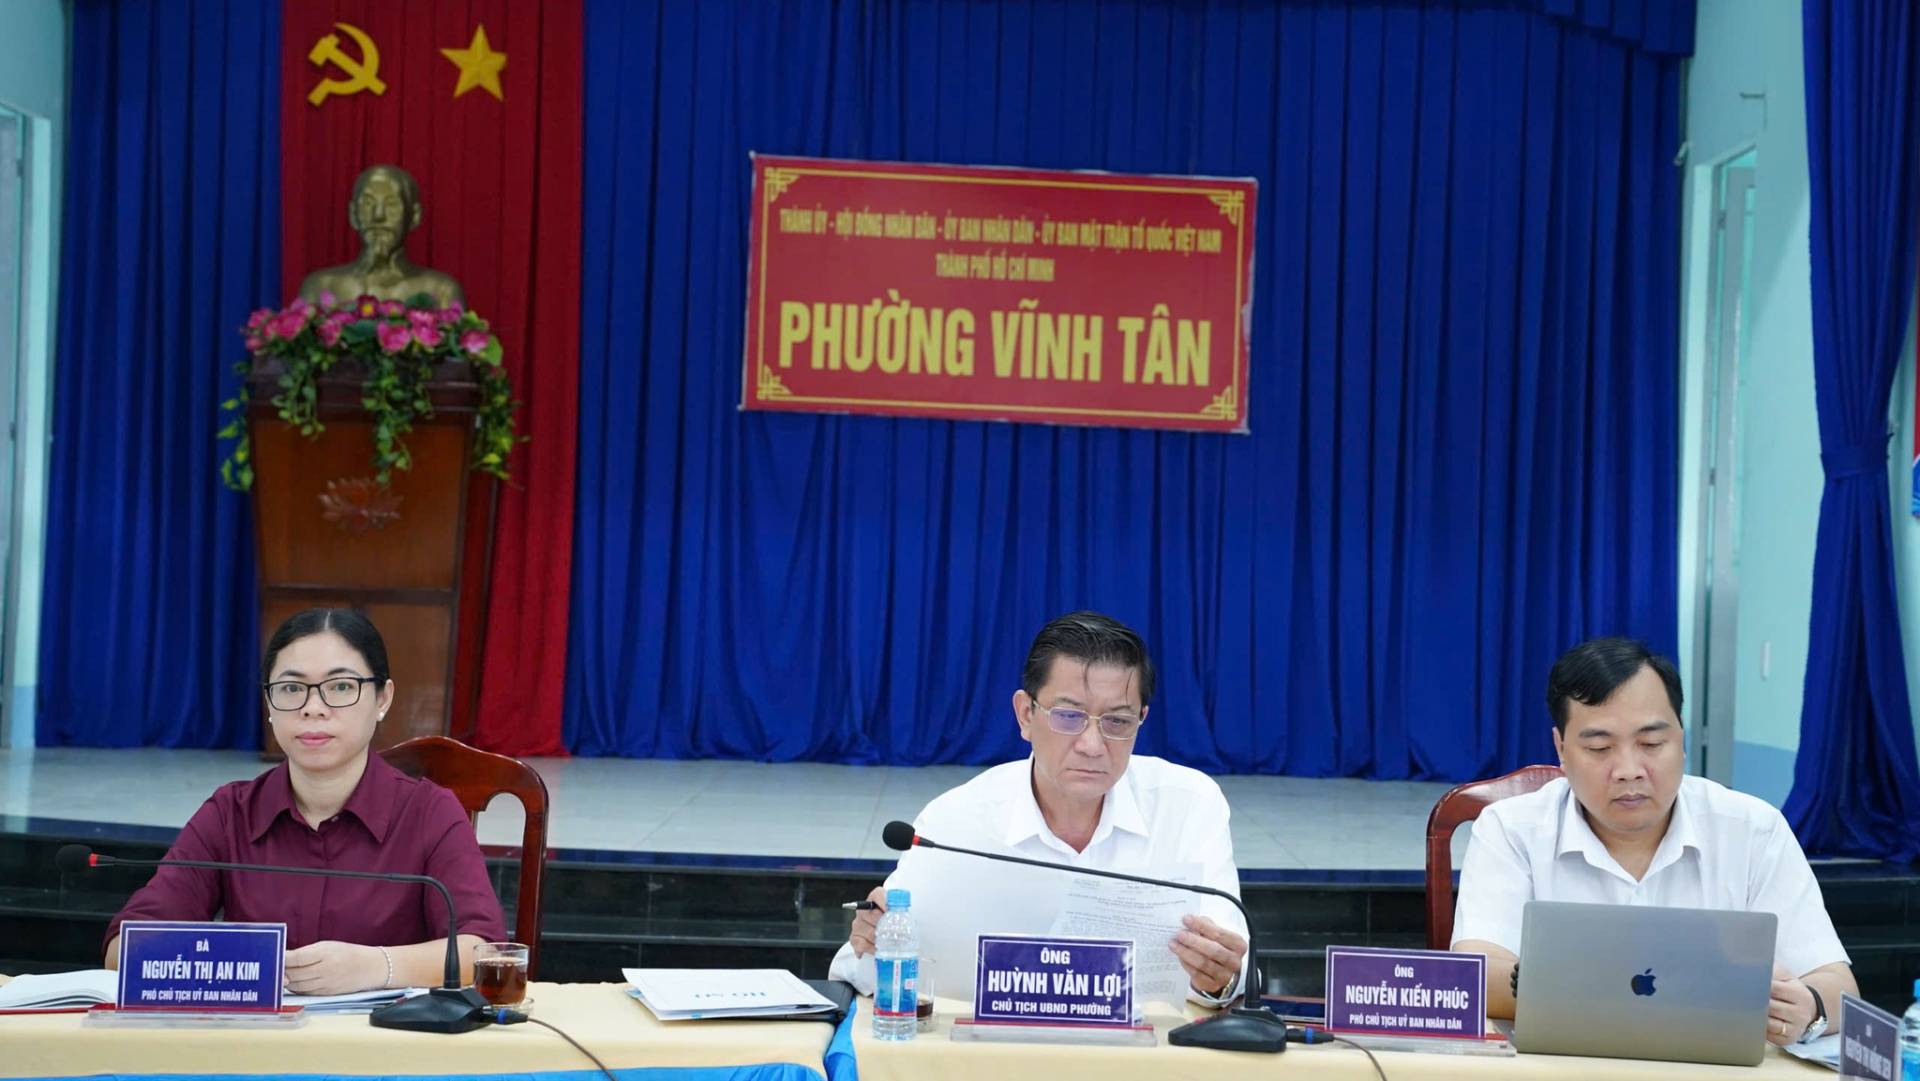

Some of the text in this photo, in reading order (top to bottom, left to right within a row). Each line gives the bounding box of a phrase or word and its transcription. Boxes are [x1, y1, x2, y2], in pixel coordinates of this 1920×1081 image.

[780, 205, 813, 233] THÀNH
[835, 207, 853, 240] HỘI
[884, 210, 913, 239] NHÂN
[914, 211, 936, 240] DÂN
[960, 216, 981, 242] BAN
[982, 214, 1011, 243] NHÂN
[1012, 215, 1034, 244] DÂN
[1057, 222, 1078, 246] BAN
[1103, 220, 1130, 254] TRẬN
[1132, 217, 1146, 249] TỔ
[1147, 219, 1173, 252] QUỐC
[1175, 223, 1197, 257] VIỆT
[1198, 229, 1222, 254] NAM
[936, 248, 968, 279] THÀNH
[970, 248, 990, 280] PHỐ
[1008, 252, 1025, 281] CHÍ
[1027, 257, 1056, 283] MINH
[779, 289, 1211, 387] PHƯỜNG VĨNH TÂN
[196, 938, 209, 952] BÀ
[1040, 947, 1071, 965] ÔNG
[142, 954, 191, 980] NGUYỄN
[194, 960, 213, 984] THỊ
[236, 961, 260, 981] KIM
[1394, 964, 1414, 978] ÔNG
[141, 988, 157, 1000] PHÓ
[158, 987, 173, 1001] CHỦ
[175, 989, 191, 1003] TỊCH
[203, 990, 220, 1001] BAN
[220, 989, 241, 1002] NHÂN
[242, 989, 258, 1002] DÂN
[988, 967, 1121, 1002] HUỲNH VĂN LỢI
[1345, 980, 1469, 1010] NGUYỄN KIẾN PHÚC
[992, 998, 1111, 1016] CHỦ TỊCH UBND PHƯỜNG
[1349, 1013, 1364, 1025] PHÓ
[1365, 1012, 1380, 1025] CHỦ
[1381, 1014, 1397, 1028] TỊCH
[1409, 1017, 1425, 1028] BAN
[1425, 1016, 1445, 1029] NHÂN
[1447, 1017, 1462, 1030] DÂN
